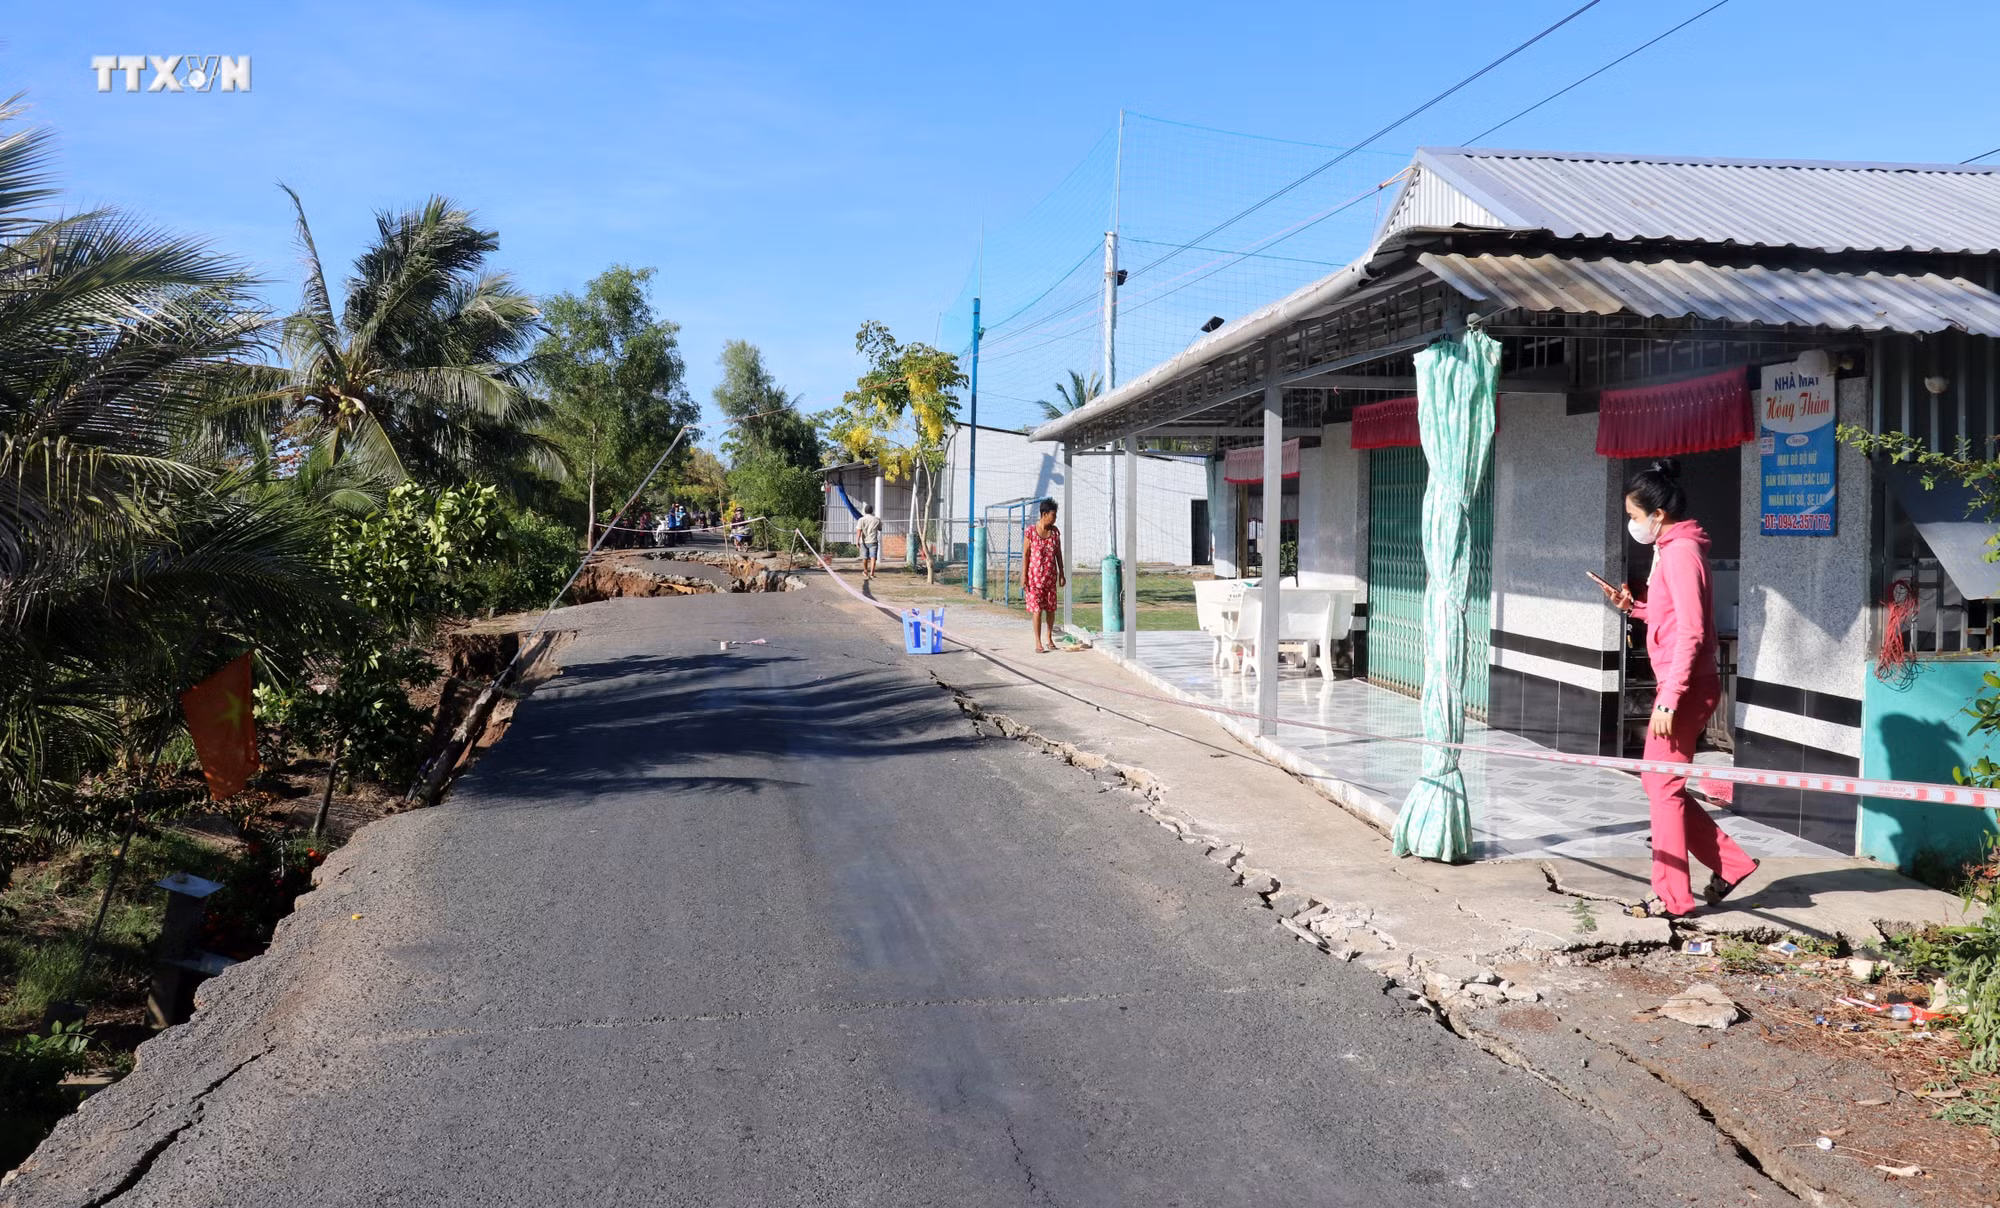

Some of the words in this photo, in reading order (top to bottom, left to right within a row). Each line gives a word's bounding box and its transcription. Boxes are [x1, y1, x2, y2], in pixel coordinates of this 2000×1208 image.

[1775, 371, 1796, 391] NHÀ
[1776, 454, 1789, 466] MAY
[1787, 473, 1802, 486] THUN
[1803, 470, 1815, 485] CÁC
[1816, 472, 1830, 487] LOẠI
[1768, 492, 1784, 508] NHẬN
